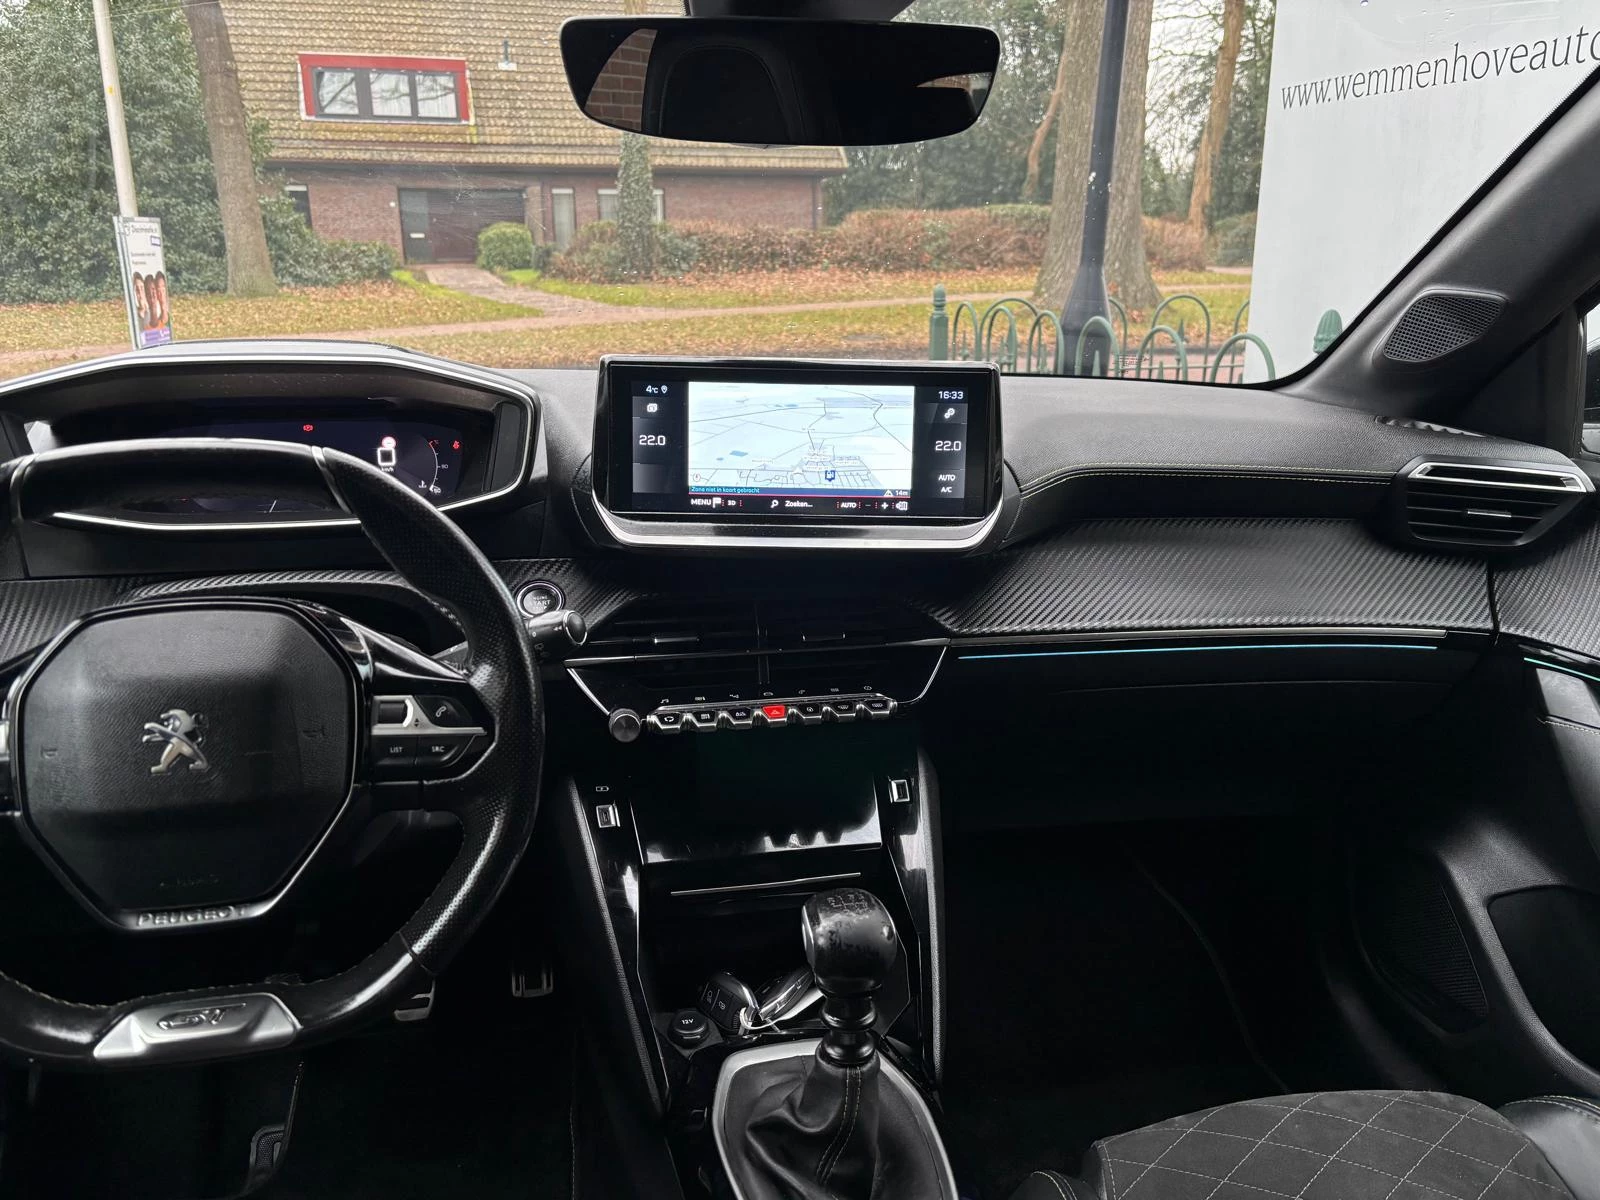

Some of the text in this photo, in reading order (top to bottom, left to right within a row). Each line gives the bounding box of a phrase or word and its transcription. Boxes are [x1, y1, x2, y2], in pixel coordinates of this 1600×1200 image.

[938, 390, 964, 400] 16:33
[638, 434, 666, 446] 22.0
[934, 440, 962, 452] 22.0
[938, 474, 956, 482] AUTO
[690, 498, 712, 506] MENU
[390, 746, 403, 754] LIST
[431, 745, 445, 753] SRC
